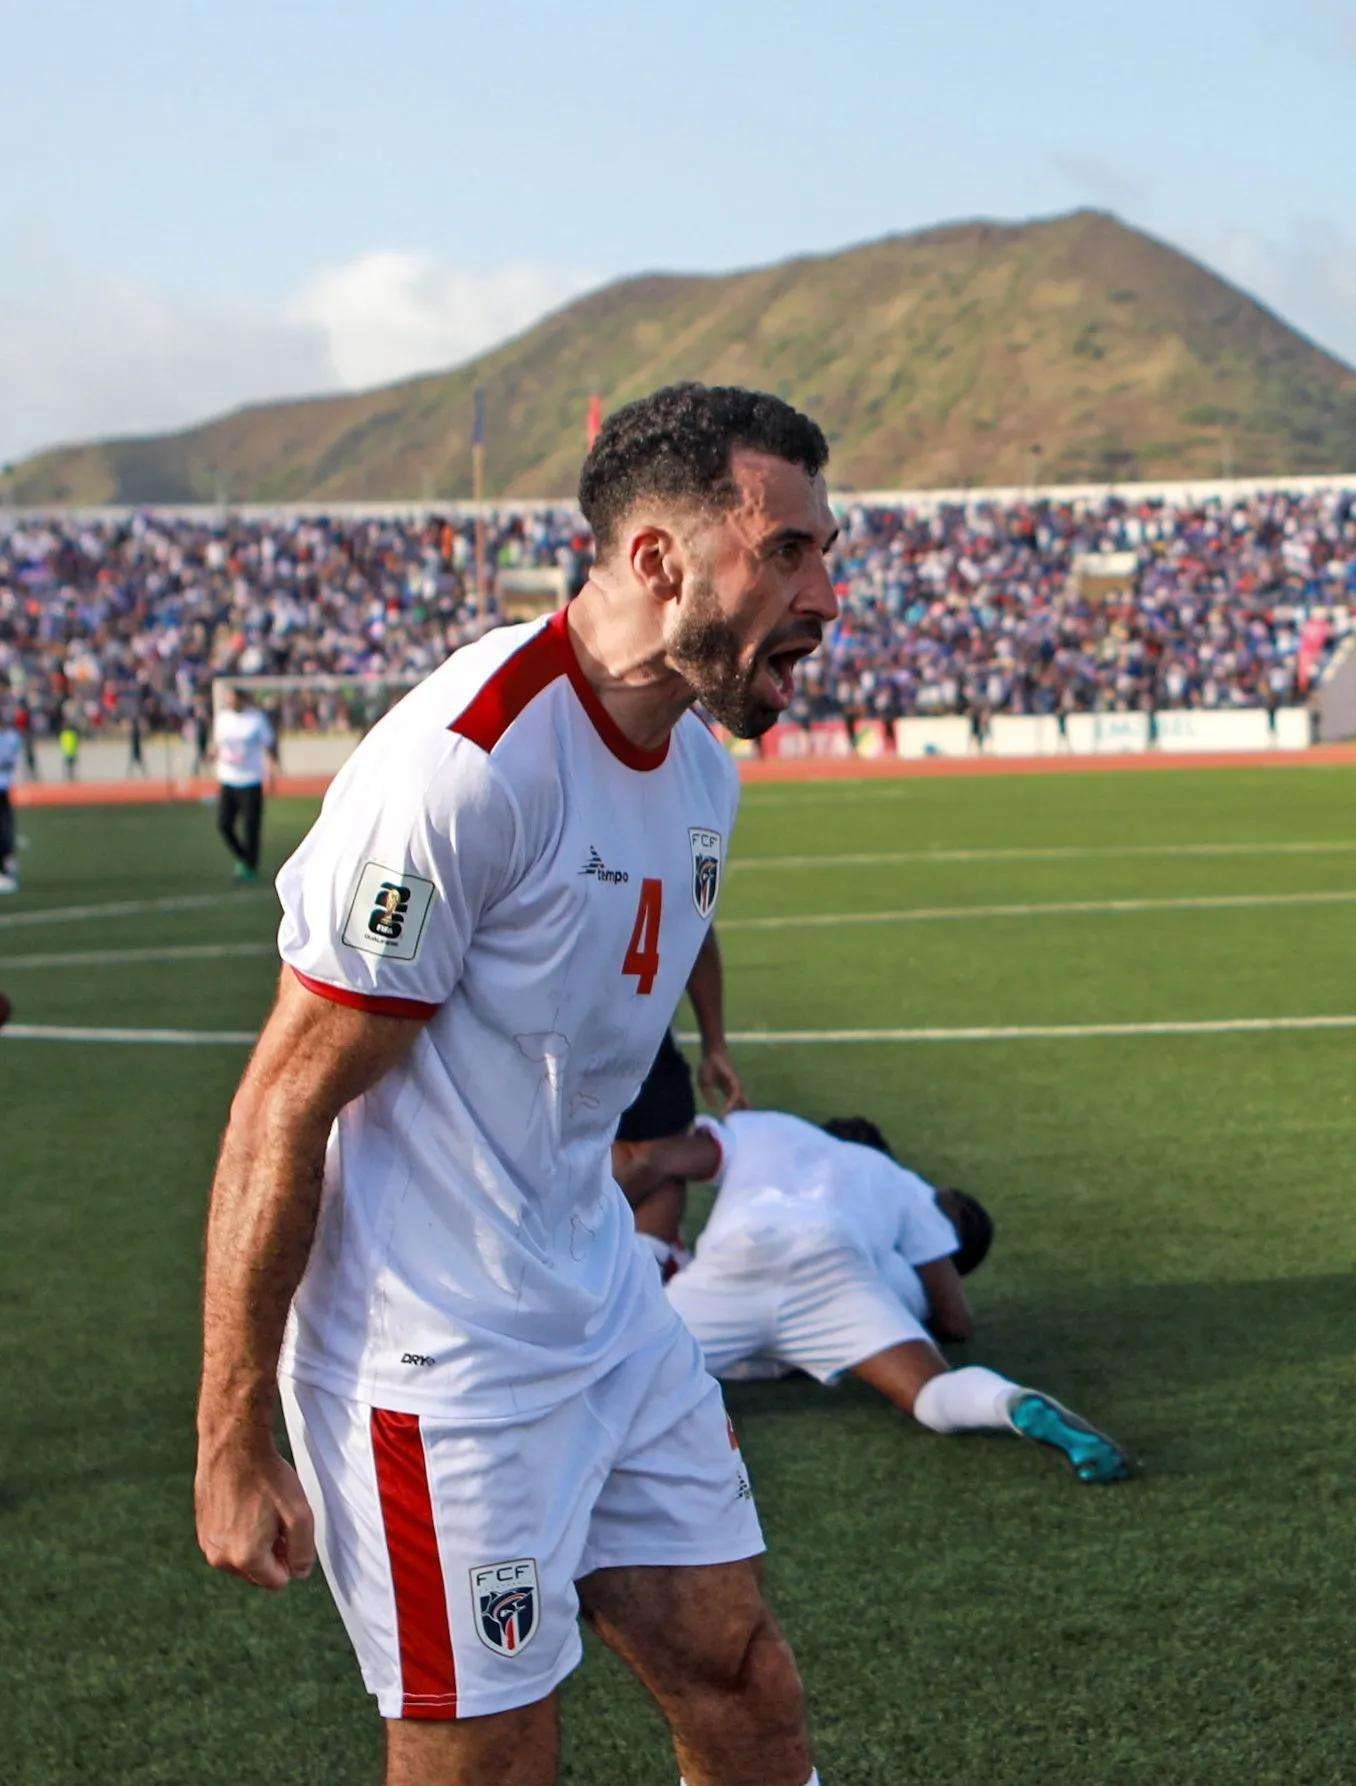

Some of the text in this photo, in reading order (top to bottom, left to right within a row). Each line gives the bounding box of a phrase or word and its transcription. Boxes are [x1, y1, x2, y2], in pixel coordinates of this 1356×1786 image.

[691, 833, 717, 848] FCF
[597, 867, 629, 885] tempo
[621, 877, 663, 995] 4
[476, 1564, 530, 1586] FCF
